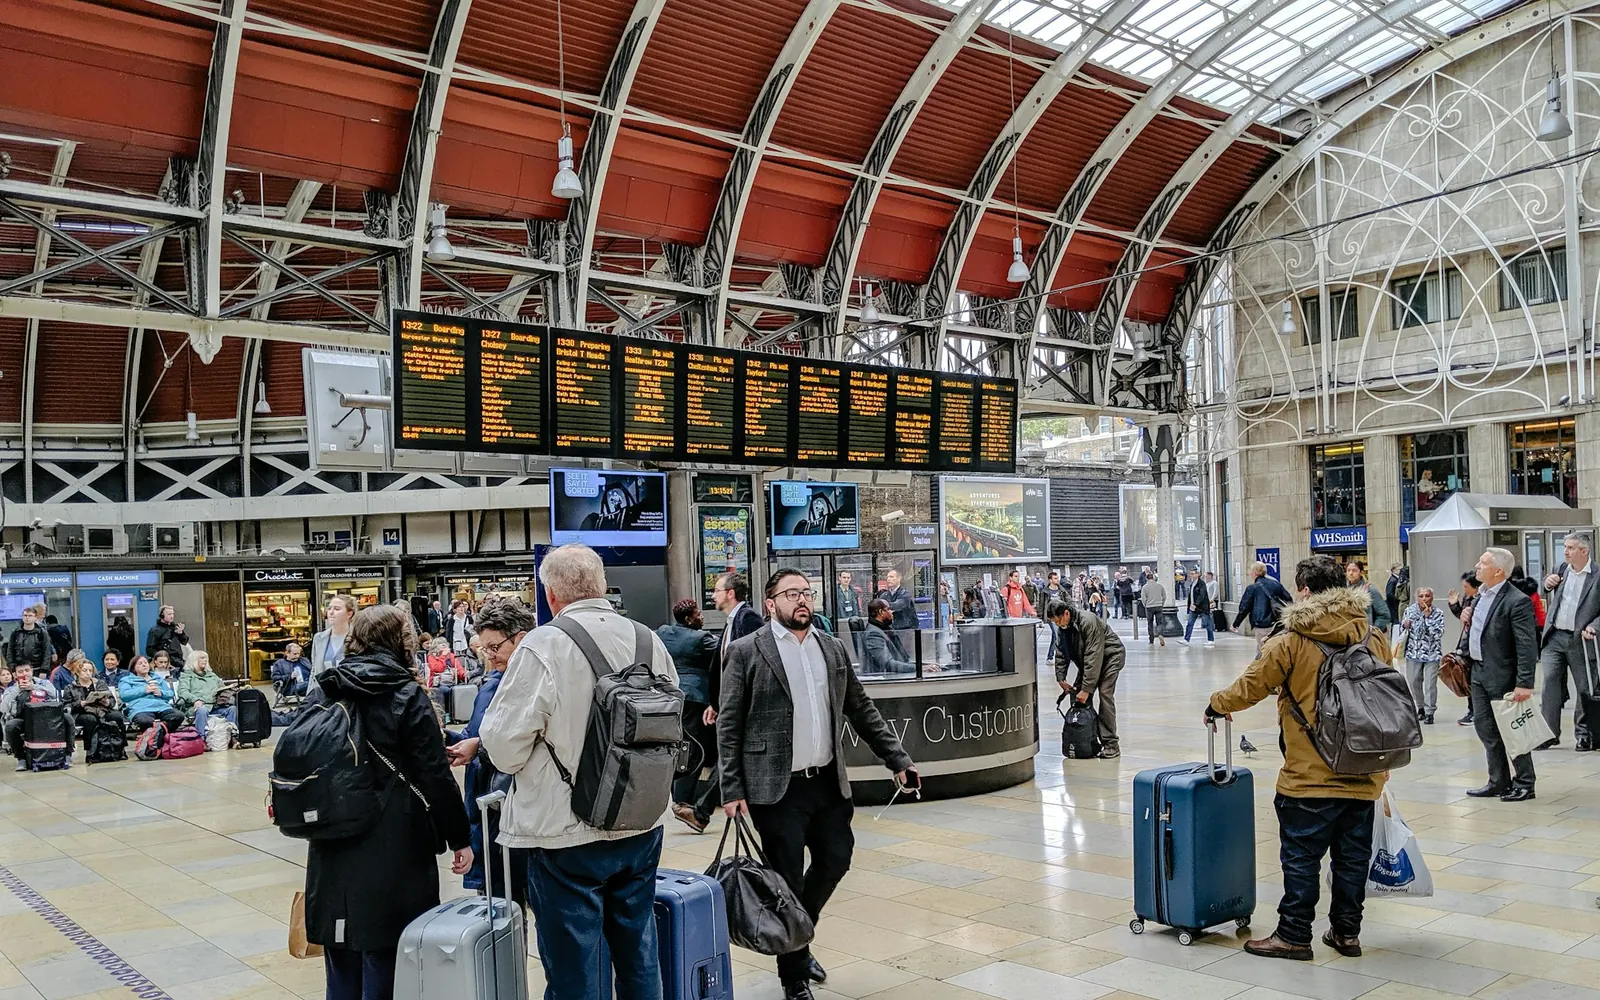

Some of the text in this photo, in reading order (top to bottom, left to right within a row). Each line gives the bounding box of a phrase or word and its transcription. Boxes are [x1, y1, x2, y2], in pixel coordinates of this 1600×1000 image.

[704, 520, 745, 532] escape
[909, 526, 934, 536] Paddington
[315, 534, 326, 544] 12
[385, 531, 398, 542] 14
[1314, 532, 1364, 544] WHSmith
[706, 542, 724, 552] YOUR
[1258, 553, 1278, 563] WH
[1374, 862, 1401, 877] Together
